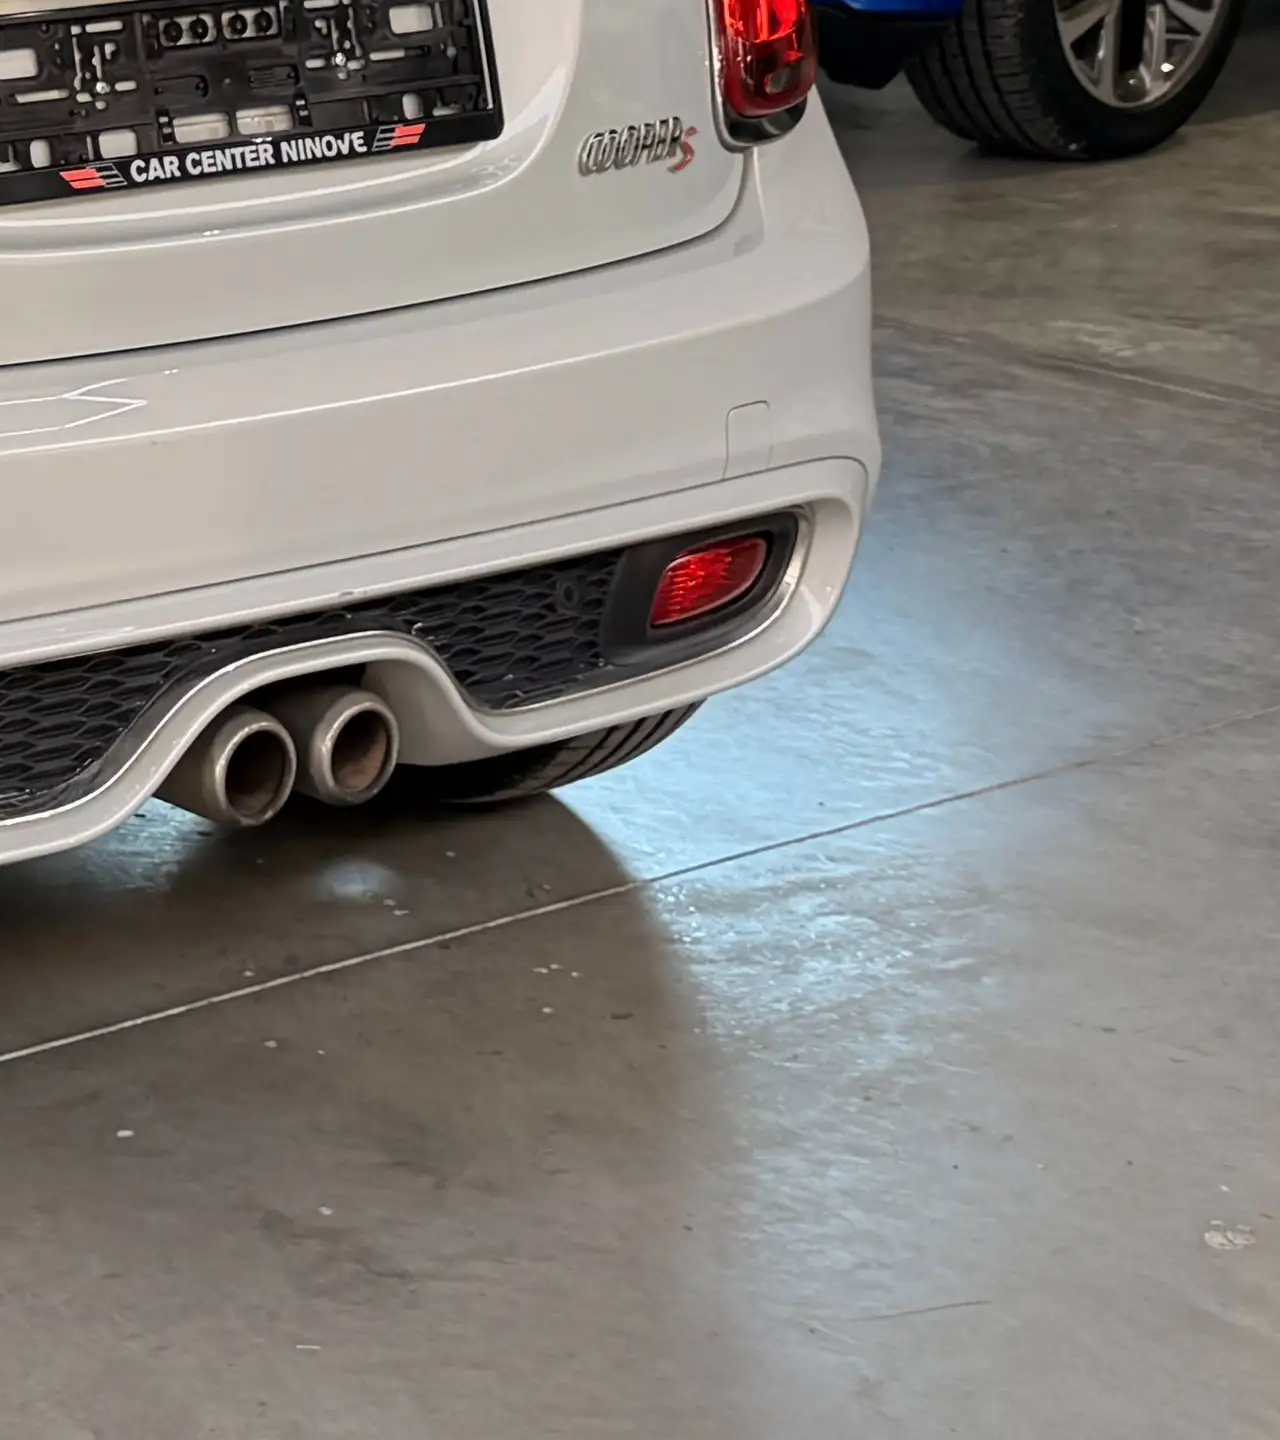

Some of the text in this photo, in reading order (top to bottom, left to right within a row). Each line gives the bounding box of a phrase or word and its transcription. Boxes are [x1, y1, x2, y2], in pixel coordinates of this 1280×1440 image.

[130, 131, 368, 183] CAR CENTER NINOVE
[578, 116, 683, 176] COOPER
